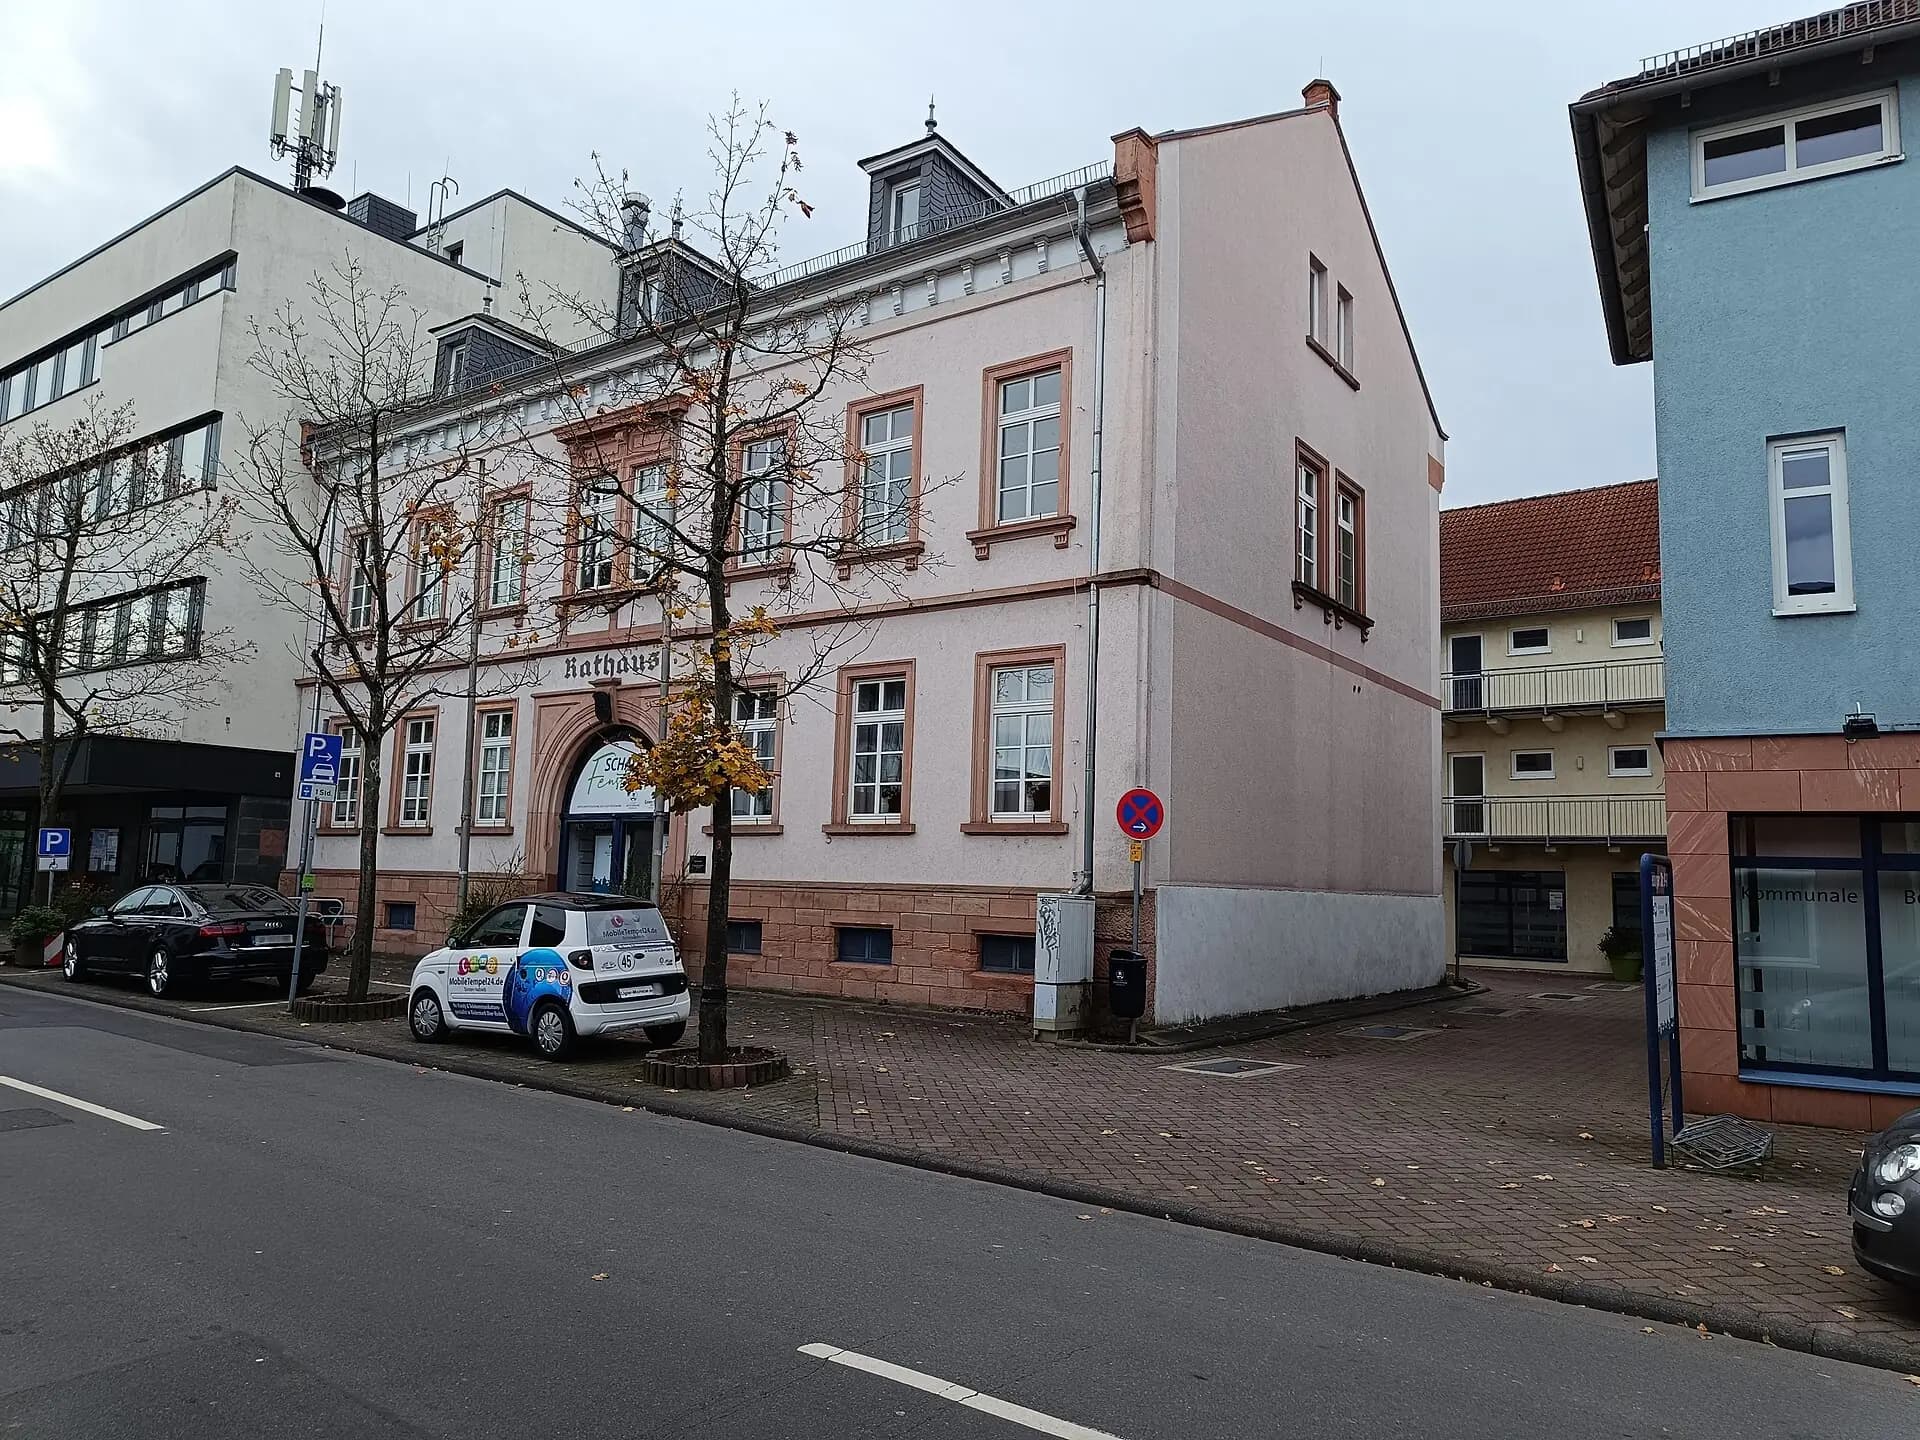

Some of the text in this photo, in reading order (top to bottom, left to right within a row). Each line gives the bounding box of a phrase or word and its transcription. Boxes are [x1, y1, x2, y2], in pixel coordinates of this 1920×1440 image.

[564, 651, 660, 679] Rathaus
[309, 736, 327, 757] P
[45, 832, 63, 852] P
[1741, 886, 1859, 903] Kommunale
[622, 954, 632, 969] 45
[449, 977, 504, 987] MobileTempel24.de
